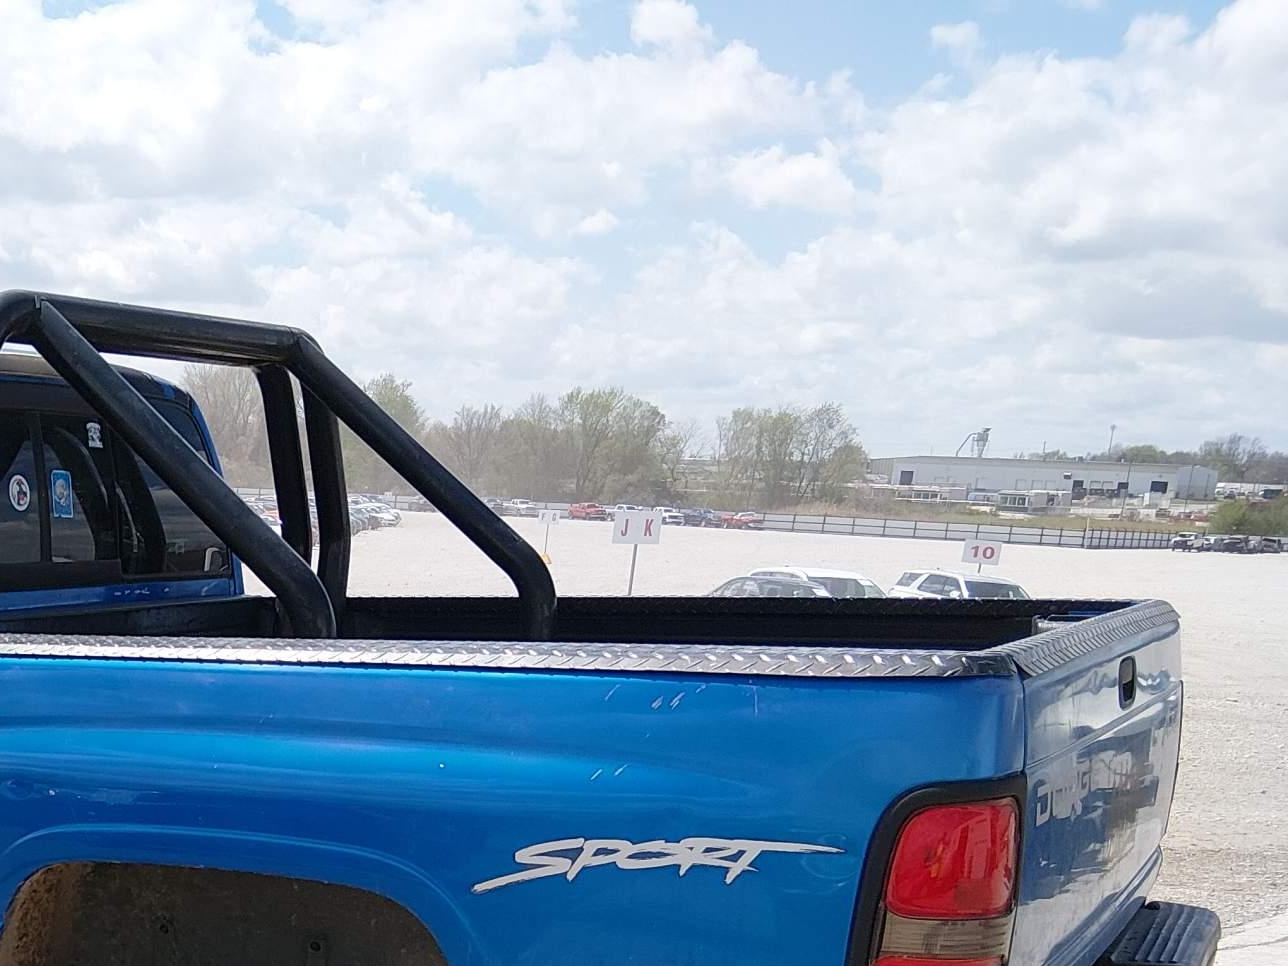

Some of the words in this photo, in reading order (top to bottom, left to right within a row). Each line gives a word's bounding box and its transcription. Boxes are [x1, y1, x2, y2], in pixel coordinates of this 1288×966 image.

[620, 518, 629, 537] J
[643, 518, 654, 537] K
[971, 545, 995, 560] 10
[470, 837, 846, 894] SPORT
